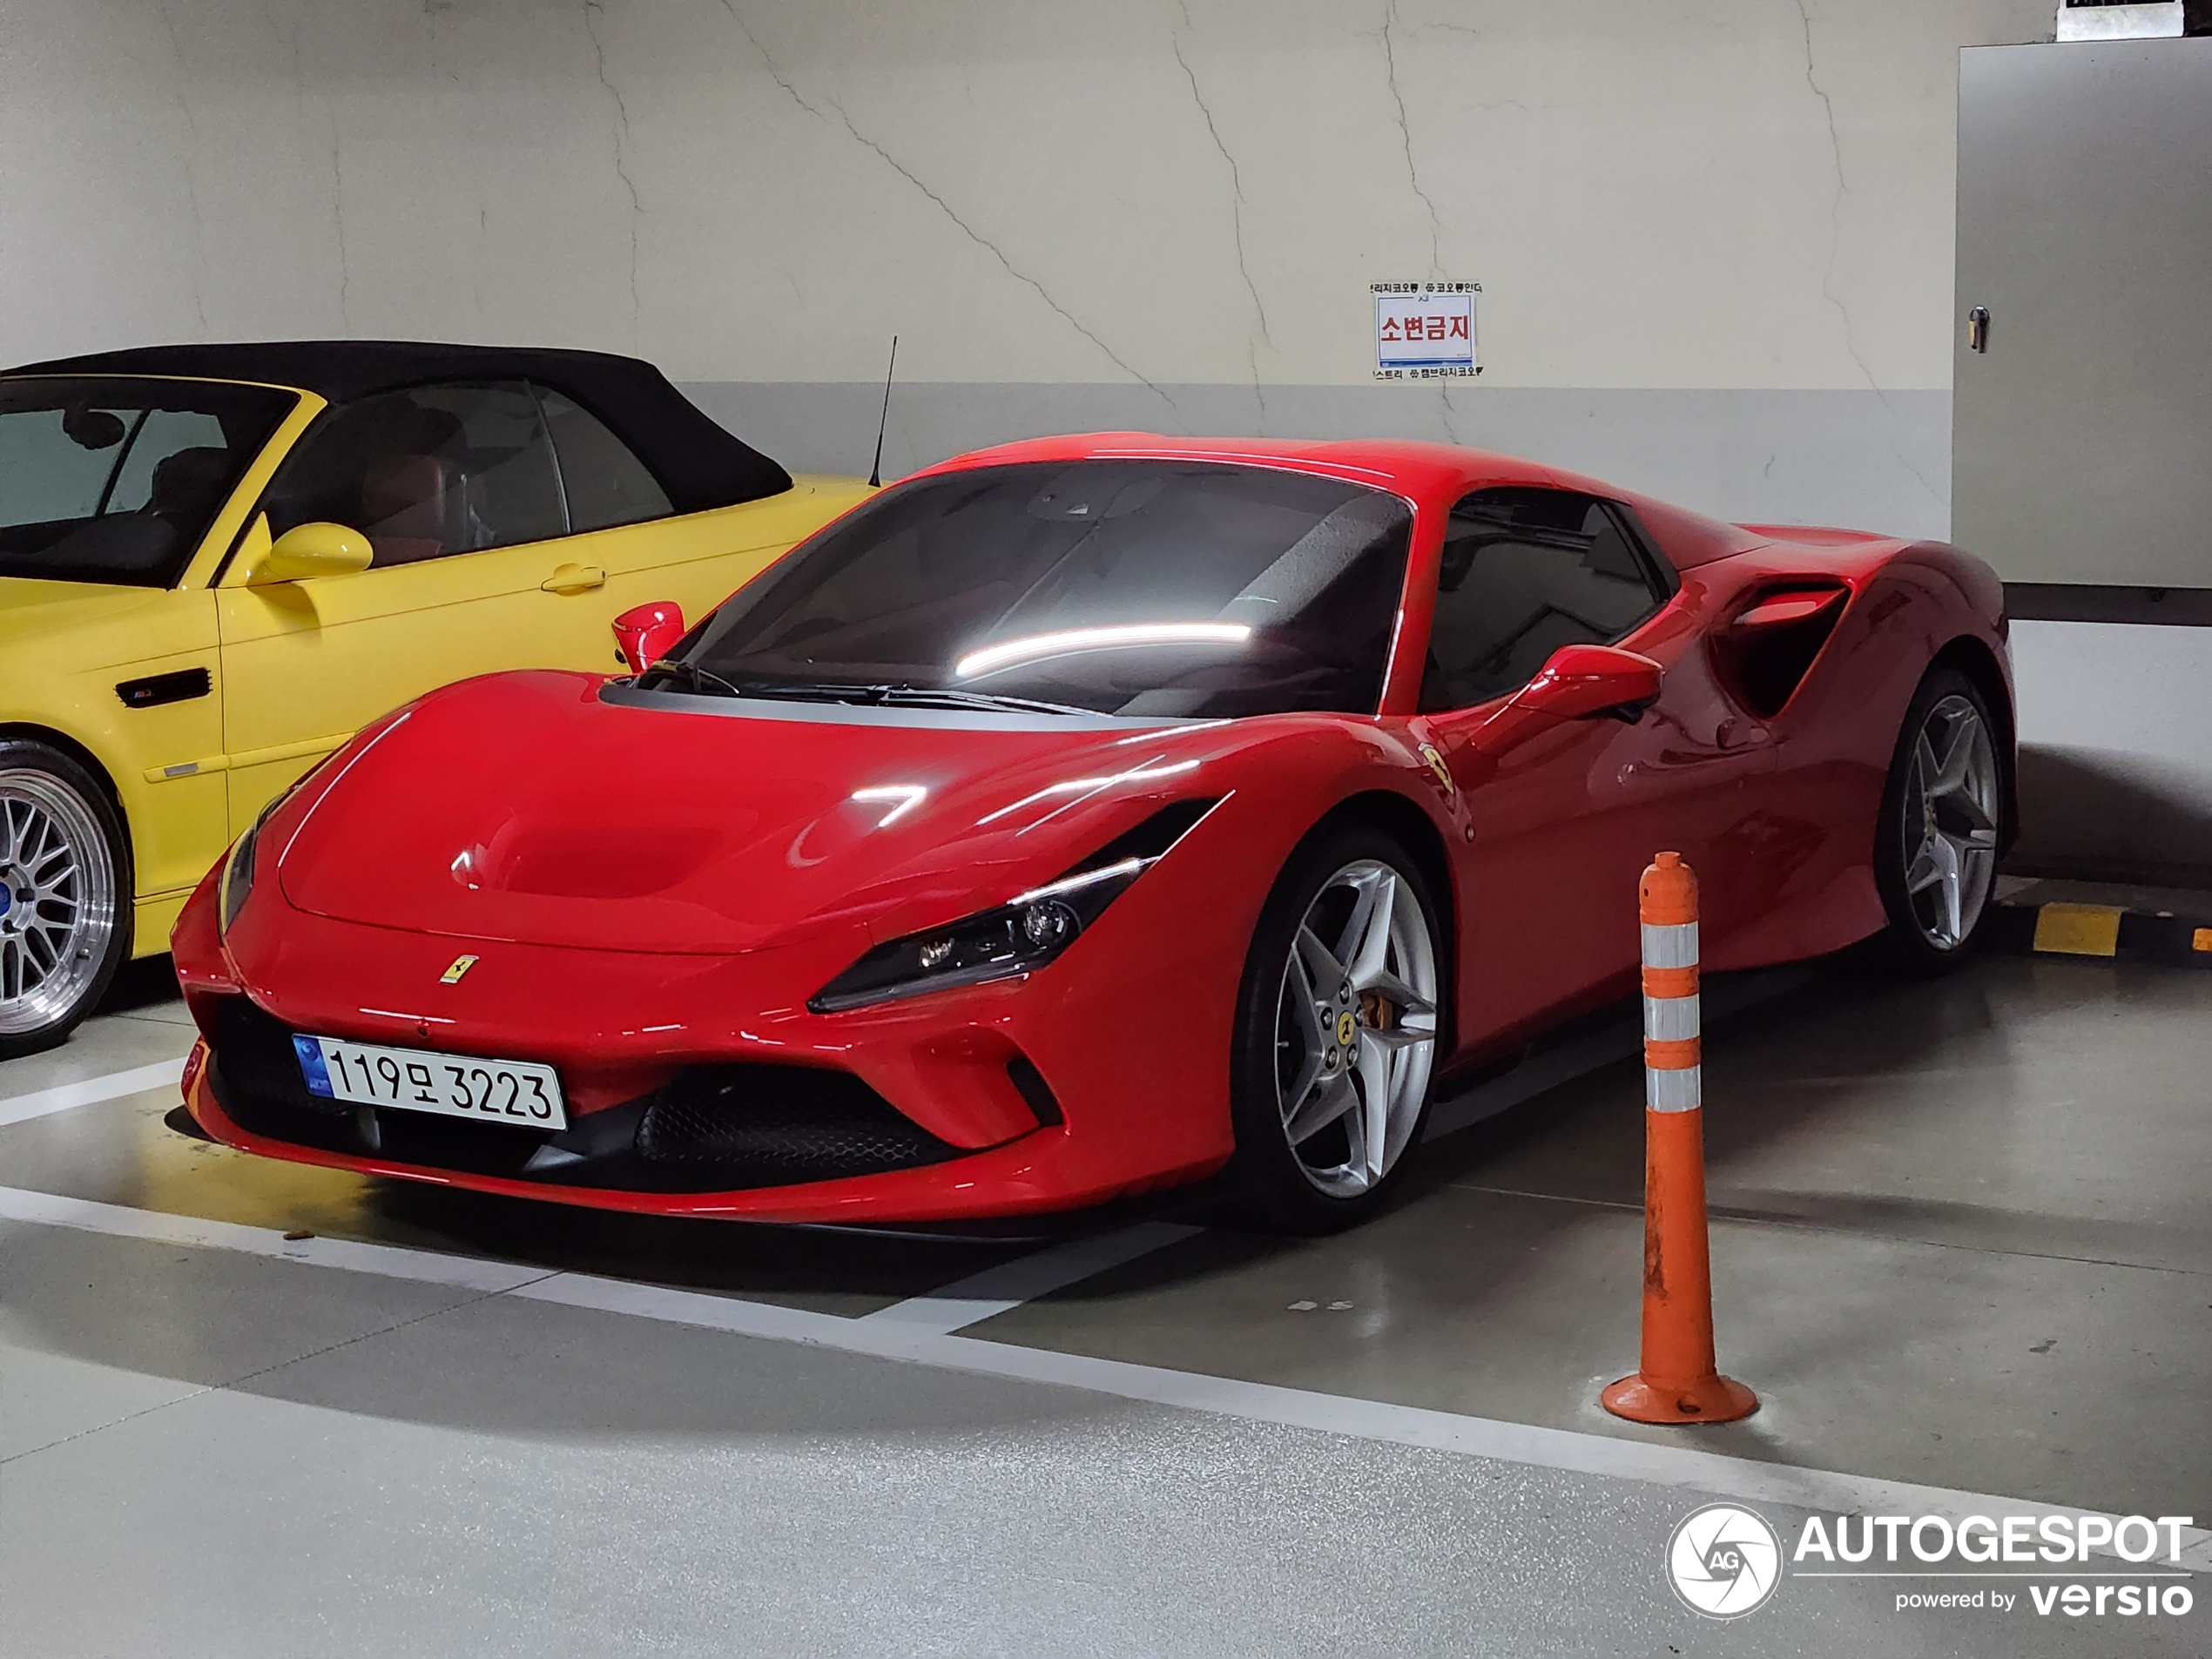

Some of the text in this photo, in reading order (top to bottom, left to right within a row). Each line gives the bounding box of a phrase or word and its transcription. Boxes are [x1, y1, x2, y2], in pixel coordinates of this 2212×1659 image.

[1381, 314, 1469, 341] 소변금지
[1372, 369, 1403, 380] 스트리
[330, 1049, 551, 1119] 119모 3223
